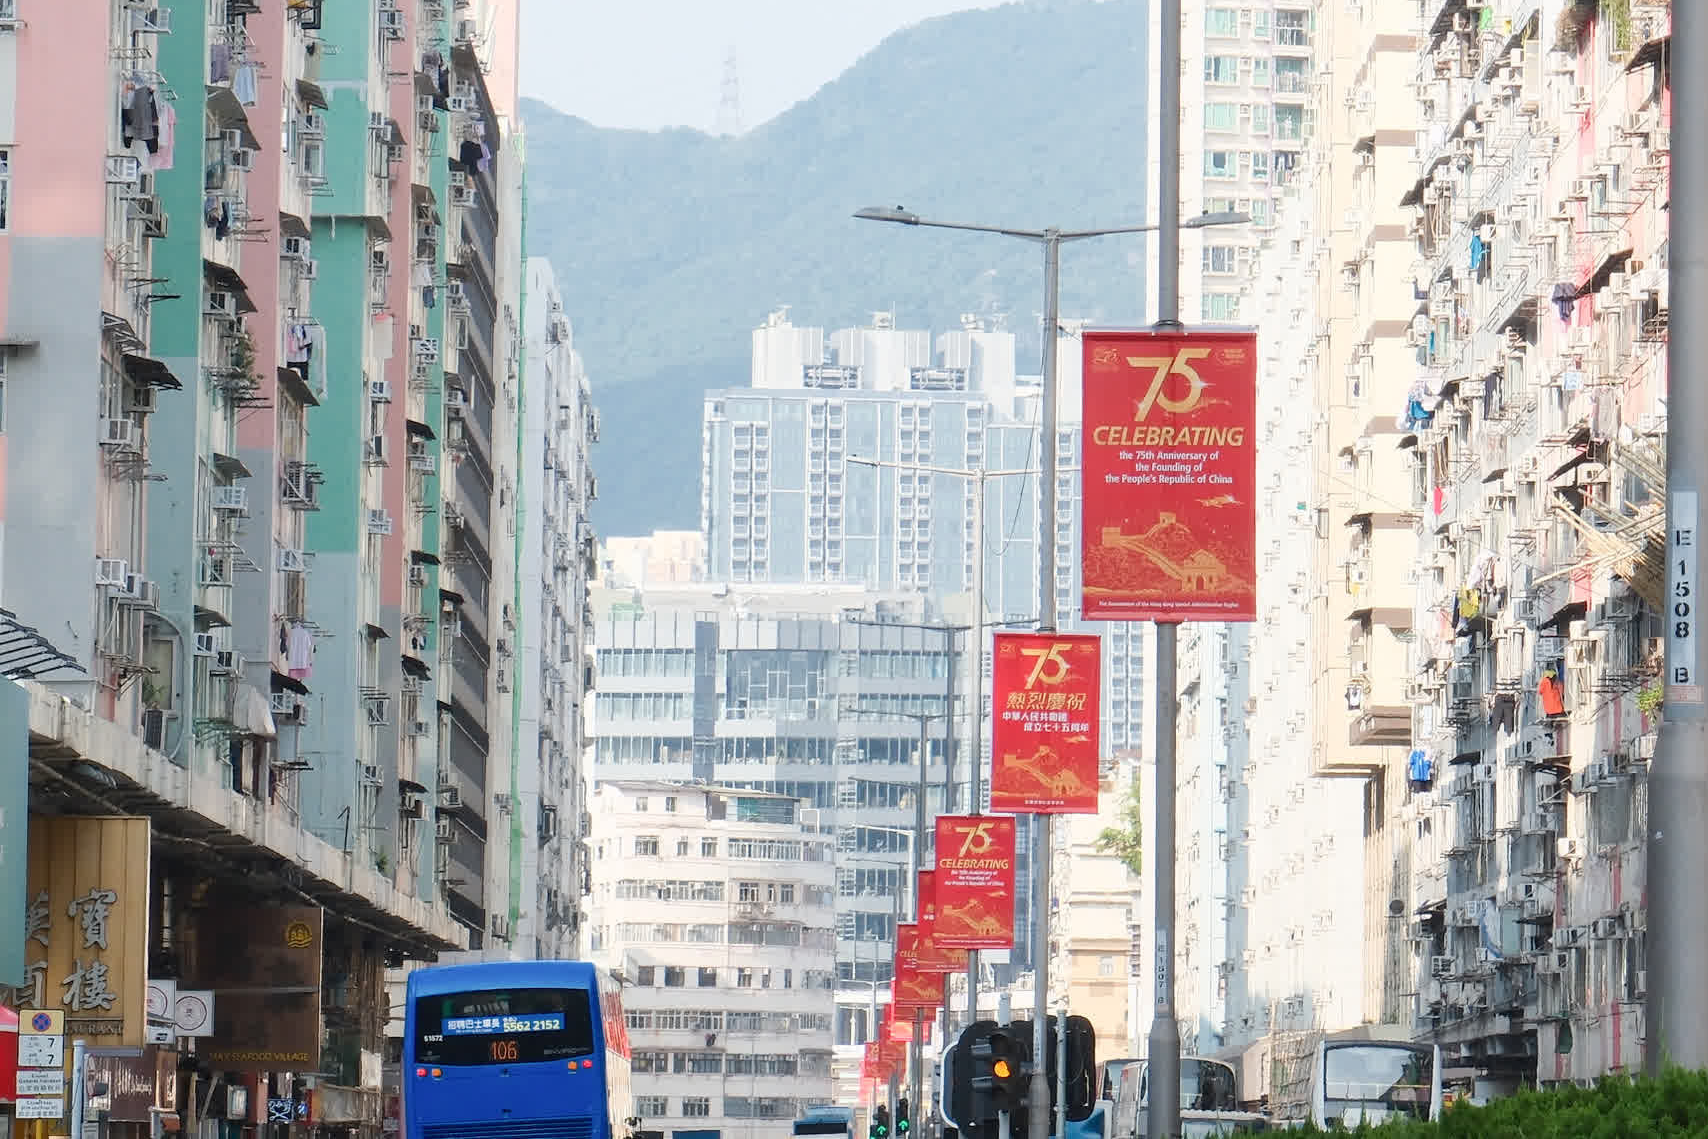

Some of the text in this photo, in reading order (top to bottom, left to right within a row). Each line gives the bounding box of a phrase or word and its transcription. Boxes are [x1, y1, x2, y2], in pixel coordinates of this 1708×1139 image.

[1126, 348, 1211, 422] 75
[1093, 426, 1245, 446] CELEBRATING
[1119, 450, 1219, 462] the 75th Anniversary of
[1135, 462, 1203, 473] the Founding of
[1105, 474, 1233, 485] the People's Republic of China
[1021, 644, 1072, 689] 75
[1006, 692, 1086, 711] 熱烈慶祝
[1002, 712, 1068, 722] 中華人民共和國
[1024, 722, 1089, 732] 成立七十五周年
[955, 822, 995, 857] 75
[939, 859, 1009, 869] CELEBRATING
[533, 1019, 560, 1031] 2152
[48, 1038, 55, 1048] 7
[491, 1041, 518, 1060] 106
[48, 1054, 55, 1064] 7
[275, 1053, 309, 1062] VILLAGE
